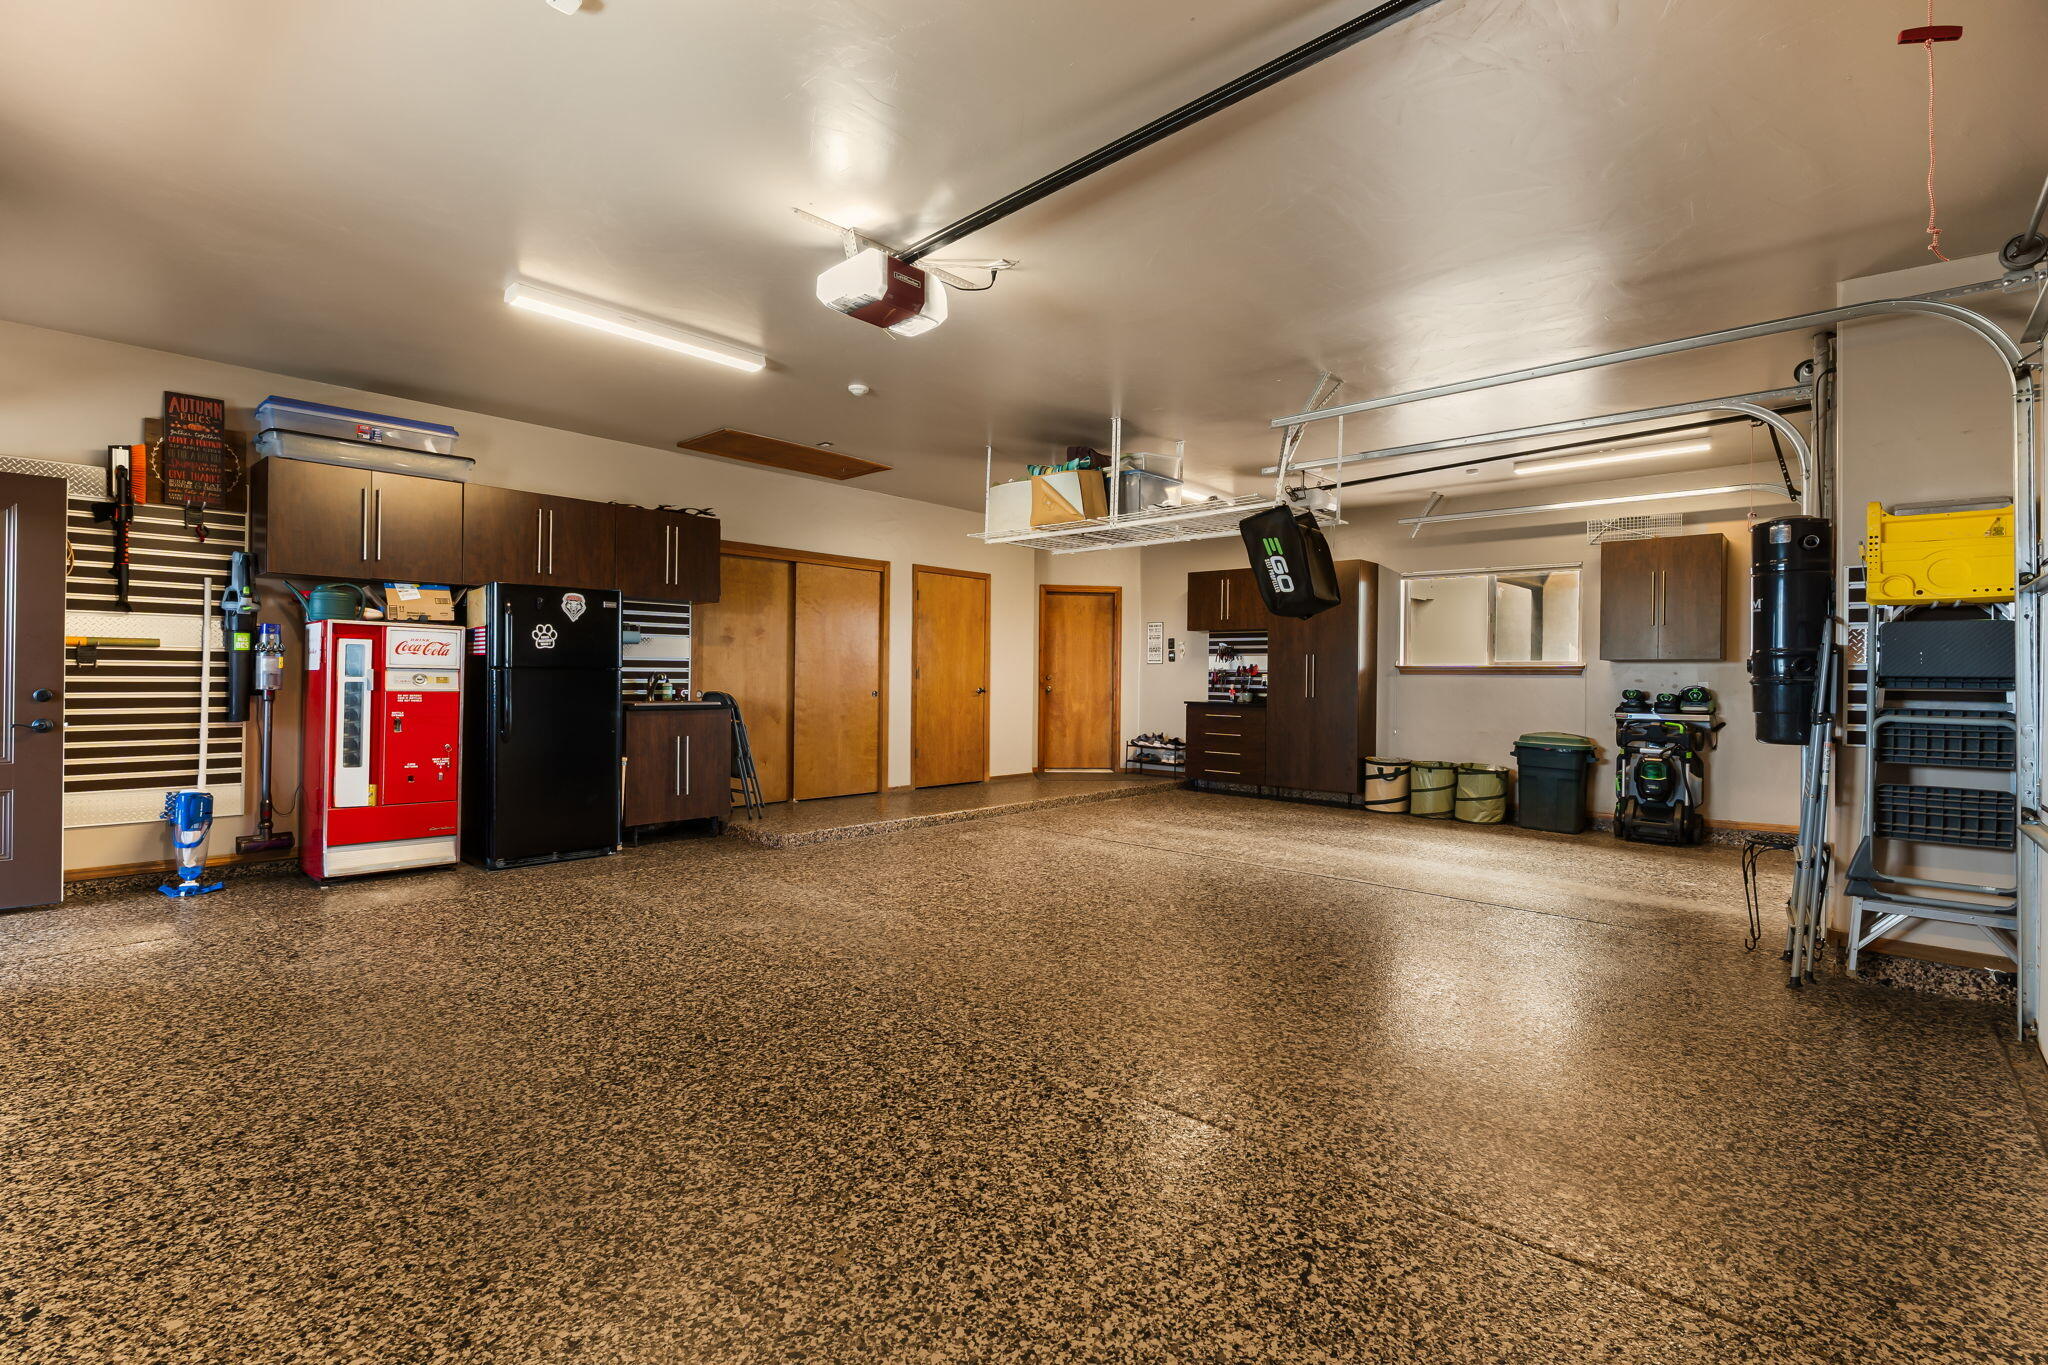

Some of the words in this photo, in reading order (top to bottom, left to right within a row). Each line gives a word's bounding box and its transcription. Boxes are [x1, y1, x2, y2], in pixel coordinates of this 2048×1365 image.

[168, 396, 222, 420] AUTUMN
[170, 429, 192, 437] gather
[194, 432, 221, 440] together
[168, 470, 185, 480] GIVE
[191, 471, 221, 484] THANKS
[1263, 537, 1295, 593] EGO
[395, 640, 453, 656] Coca-Cola
